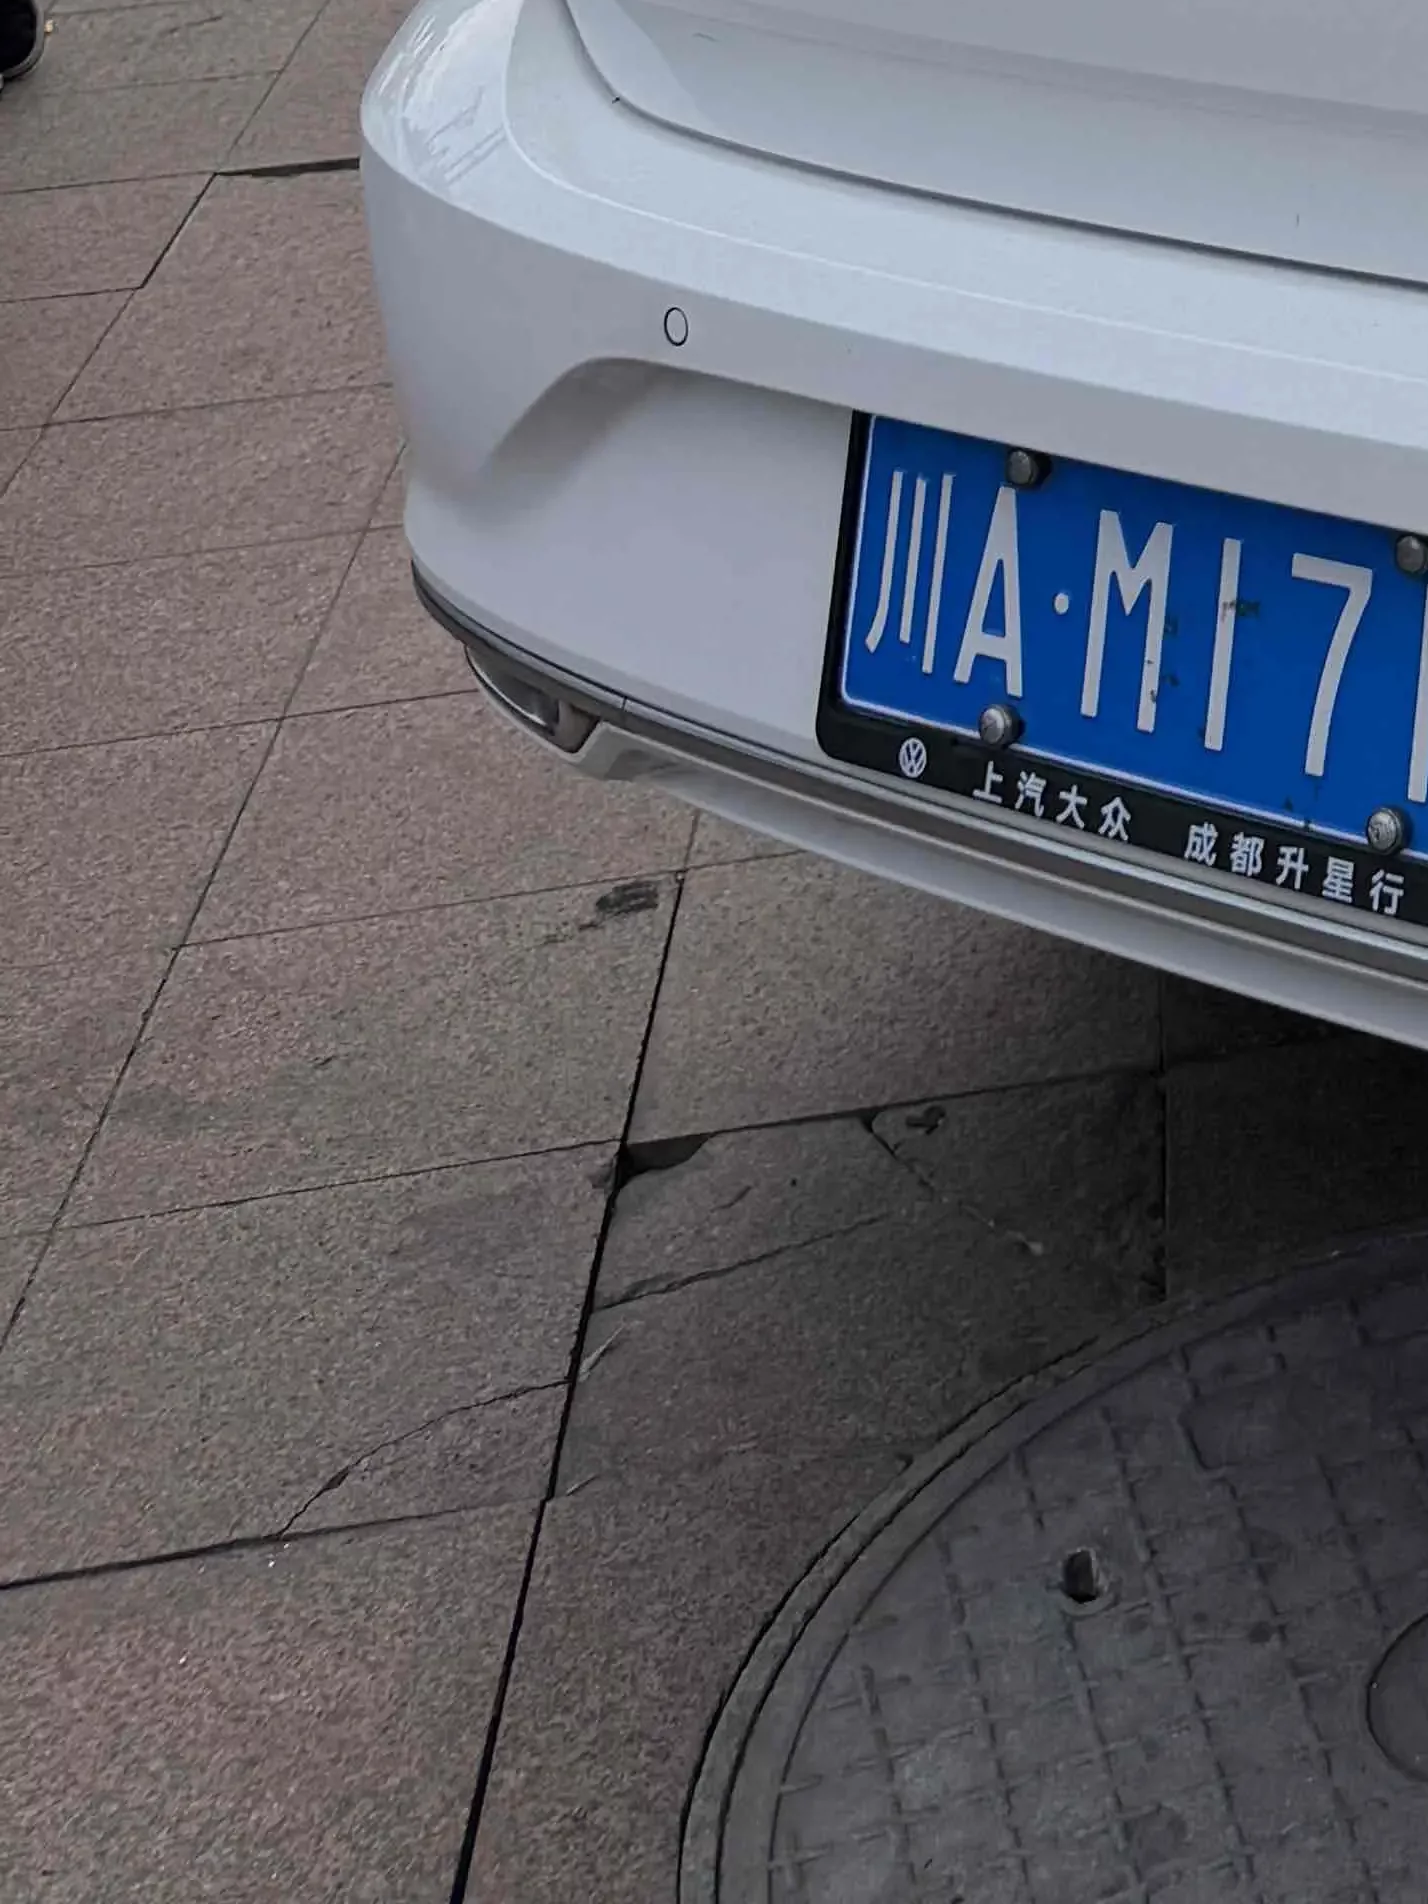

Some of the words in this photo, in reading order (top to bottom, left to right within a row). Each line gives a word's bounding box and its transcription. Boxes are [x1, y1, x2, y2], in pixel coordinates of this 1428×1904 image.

[972, 760, 1133, 844] 上汽大众
[1182, 822, 1406, 917] 成都升星行
